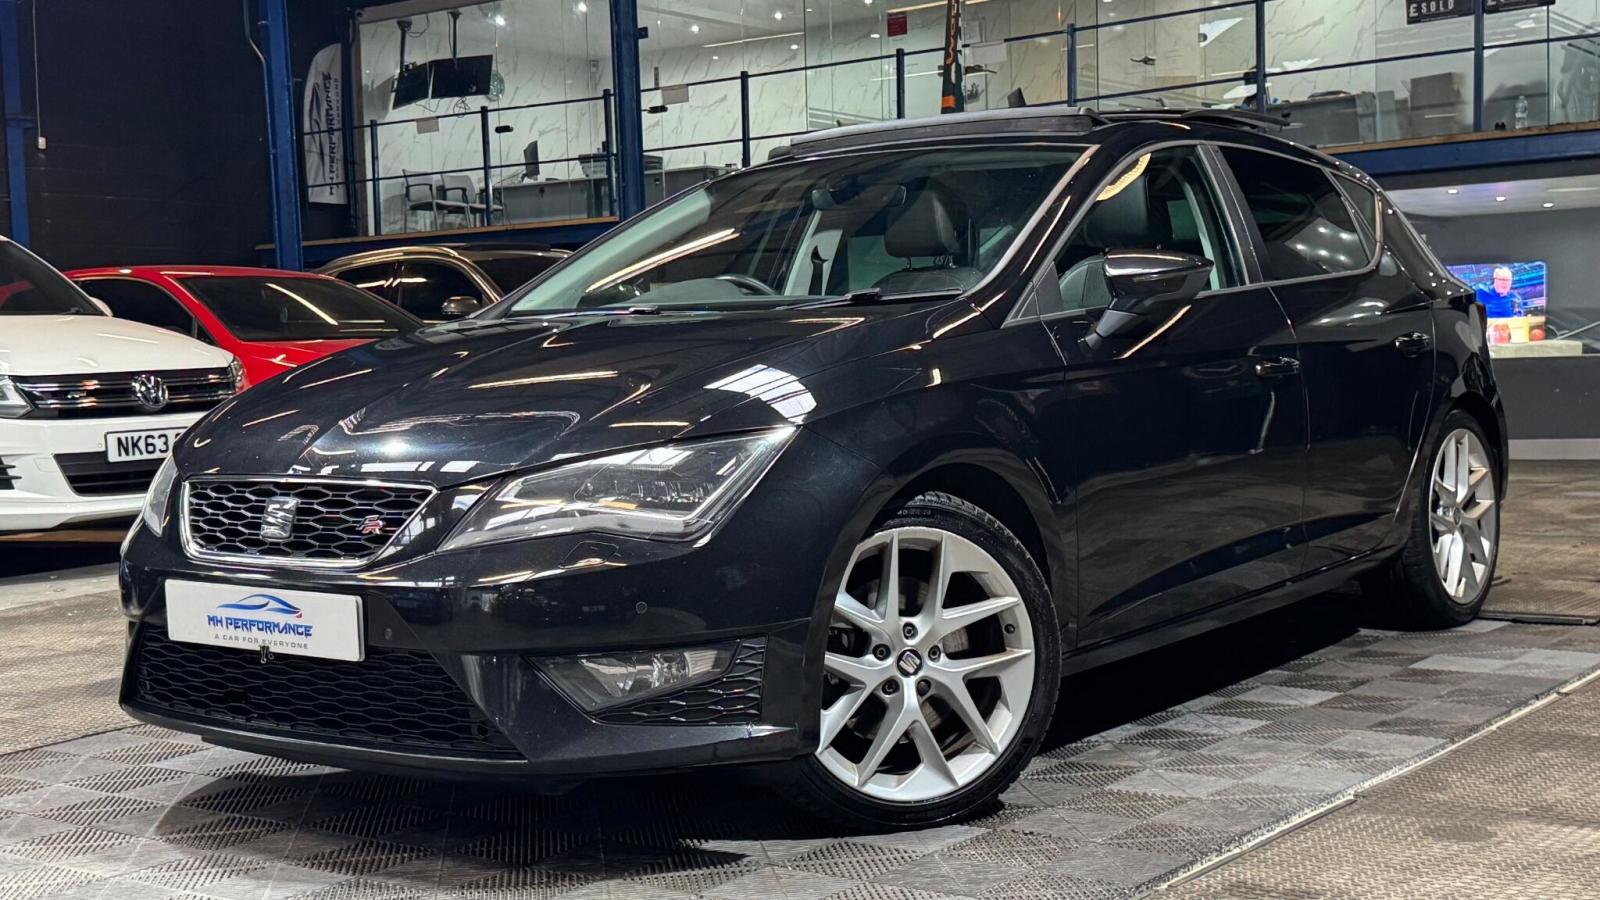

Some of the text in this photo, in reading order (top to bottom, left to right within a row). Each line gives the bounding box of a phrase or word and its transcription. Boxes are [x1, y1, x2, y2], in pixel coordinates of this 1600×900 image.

[117, 434, 170, 457] NK63
[206, 614, 313, 639] MH PERFORMANCE
[222, 634, 240, 642] CAR
[242, 637, 259, 645] FOR
[261, 639, 309, 650] EVERYONE
